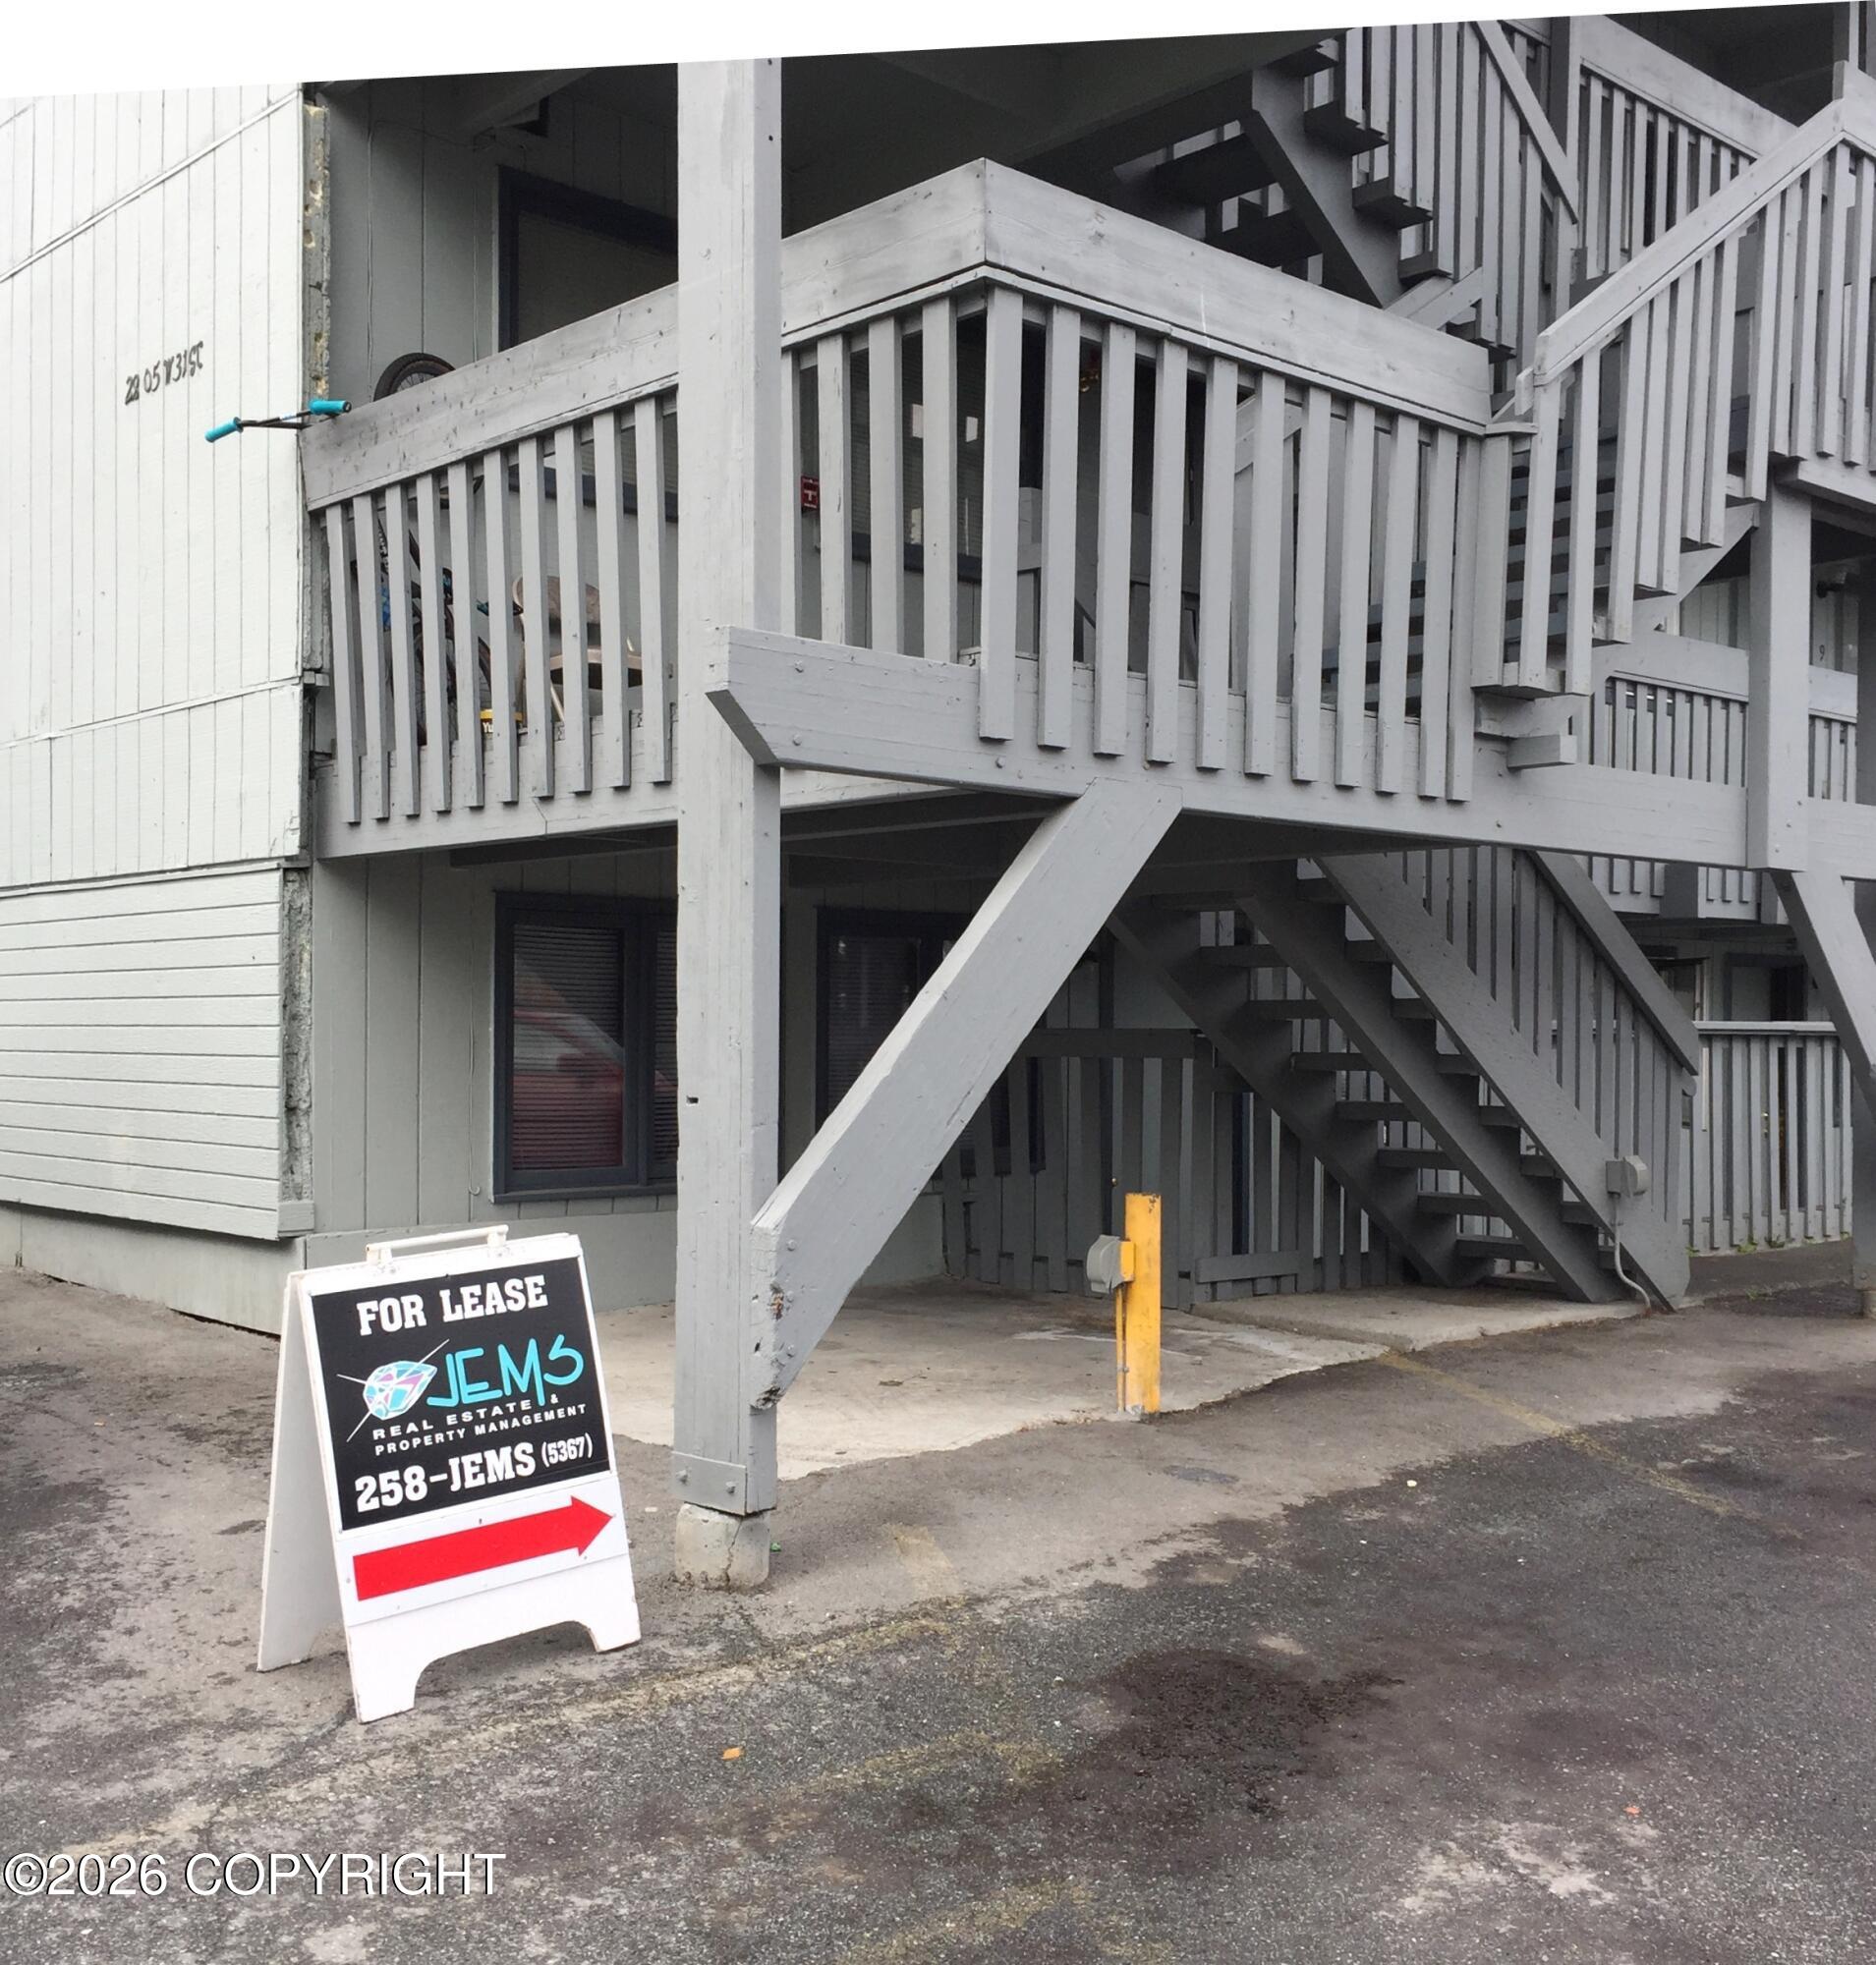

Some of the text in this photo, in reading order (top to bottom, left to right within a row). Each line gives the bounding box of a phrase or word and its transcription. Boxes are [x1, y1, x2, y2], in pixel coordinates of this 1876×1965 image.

[357, 1274, 548, 1336] FOR LEASE
[426, 1334, 584, 1406] JEMS
[372, 1393, 559, 1440] REAL ESTATE &
[374, 1403, 588, 1456] PROPERTY MANAGEMENT
[354, 1432, 594, 1513] 258-JEMS (5367)
